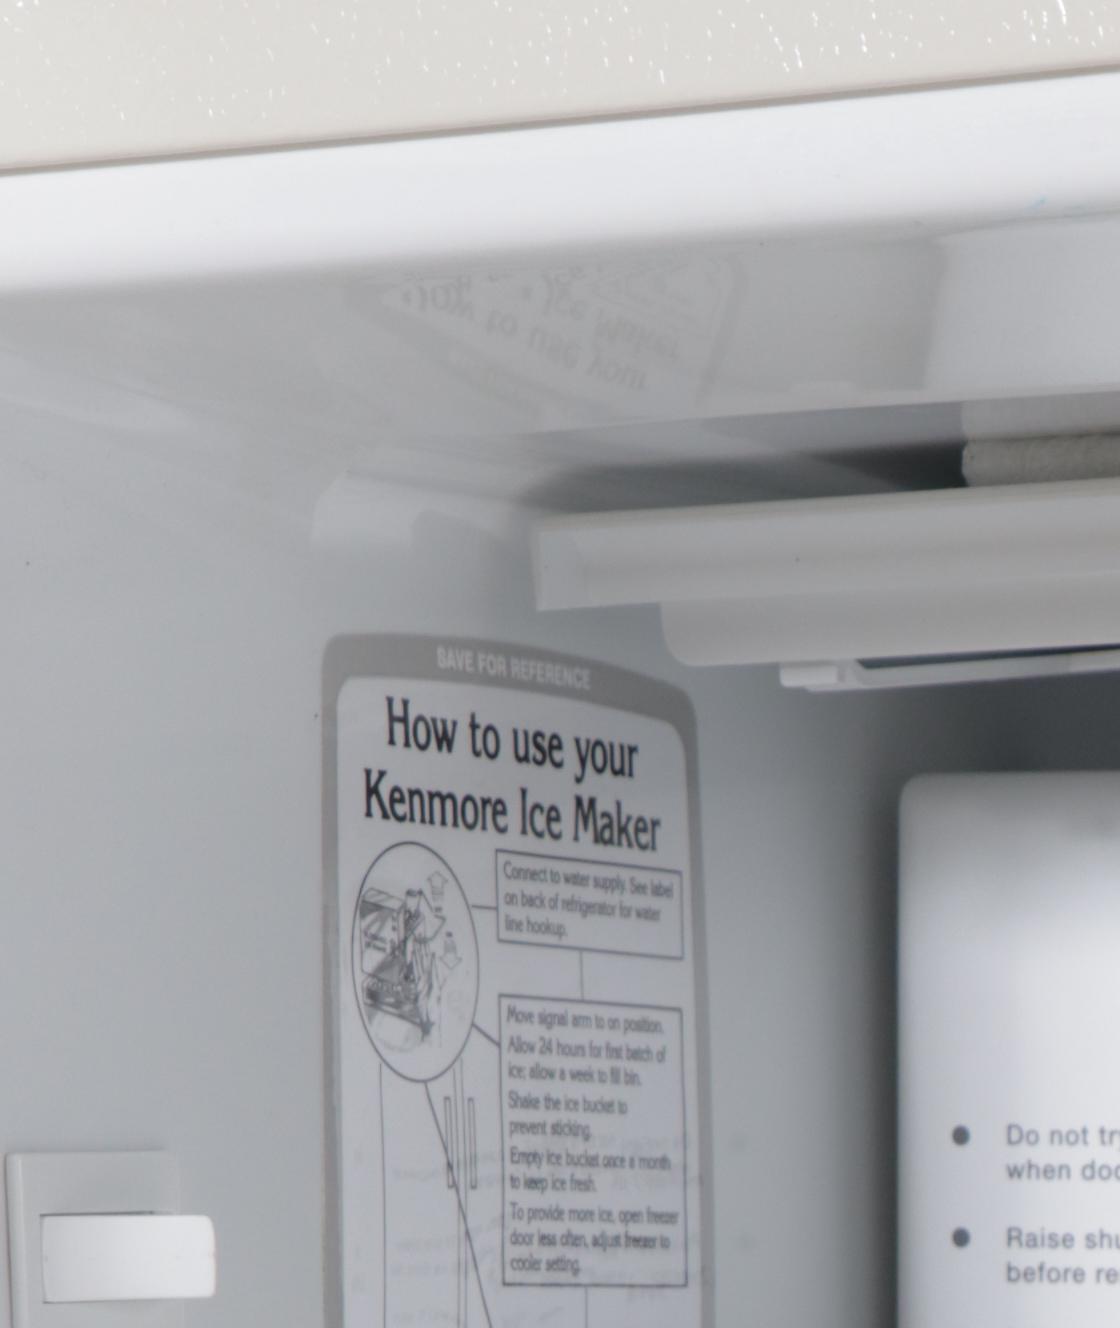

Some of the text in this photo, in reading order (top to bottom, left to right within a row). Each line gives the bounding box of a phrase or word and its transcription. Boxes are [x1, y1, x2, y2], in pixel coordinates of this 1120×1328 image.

[437, 647, 592, 690] SAVE FOR REFERENCE
[385, 696, 639, 784] How to use your
[363, 767, 661, 852] Kenmore Ice Maker
[503, 860, 548, 883] Connect
[550, 869, 560, 884] to
[563, 872, 590, 887] water
[629, 877, 648, 894] See
[651, 881, 674, 898] label
[504, 891, 661, 921] on back of refrigerator for water
[504, 914, 567, 940] line hookup.
[507, 1005, 664, 1035] Move signal arm to on position.
[507, 1036, 666, 1063] Allow 24 hours for first batch of
[529, 1062, 555, 1080] allow
[570, 1069, 594, 1083] week
[598, 1069, 607, 1084] to
[508, 1090, 627, 1114] Shake the ice bucket to
[509, 1121, 547, 1138] prevent
[1005, 1122, 1040, 1147] Do
[1048, 1125, 1089, 1147] not
[510, 1146, 544, 1169] Empty
[546, 1150, 562, 1166] ice
[566, 1150, 599, 1167] bucket
[602, 1155, 626, 1168] once
[1004, 1158, 1072, 1182] when
[510, 1175, 520, 1190] to
[523, 1174, 548, 1194] keep
[552, 1175, 567, 1191] ice
[510, 1202, 524, 1221] To
[527, 1205, 565, 1224] provide
[568, 1210, 594, 1222] more
[619, 1209, 644, 1225] open
[647, 1206, 679, 1225] freezer
[510, 1229, 535, 1245] door
[538, 1229, 557, 1246] less
[592, 1231, 622, 1252] adjust
[625, 1231, 657, 1248] freezer
[660, 1234, 670, 1248] to
[1004, 1225, 1075, 1251] Raise
[510, 1253, 542, 1271] cooler
[1003, 1260, 1086, 1286] before
